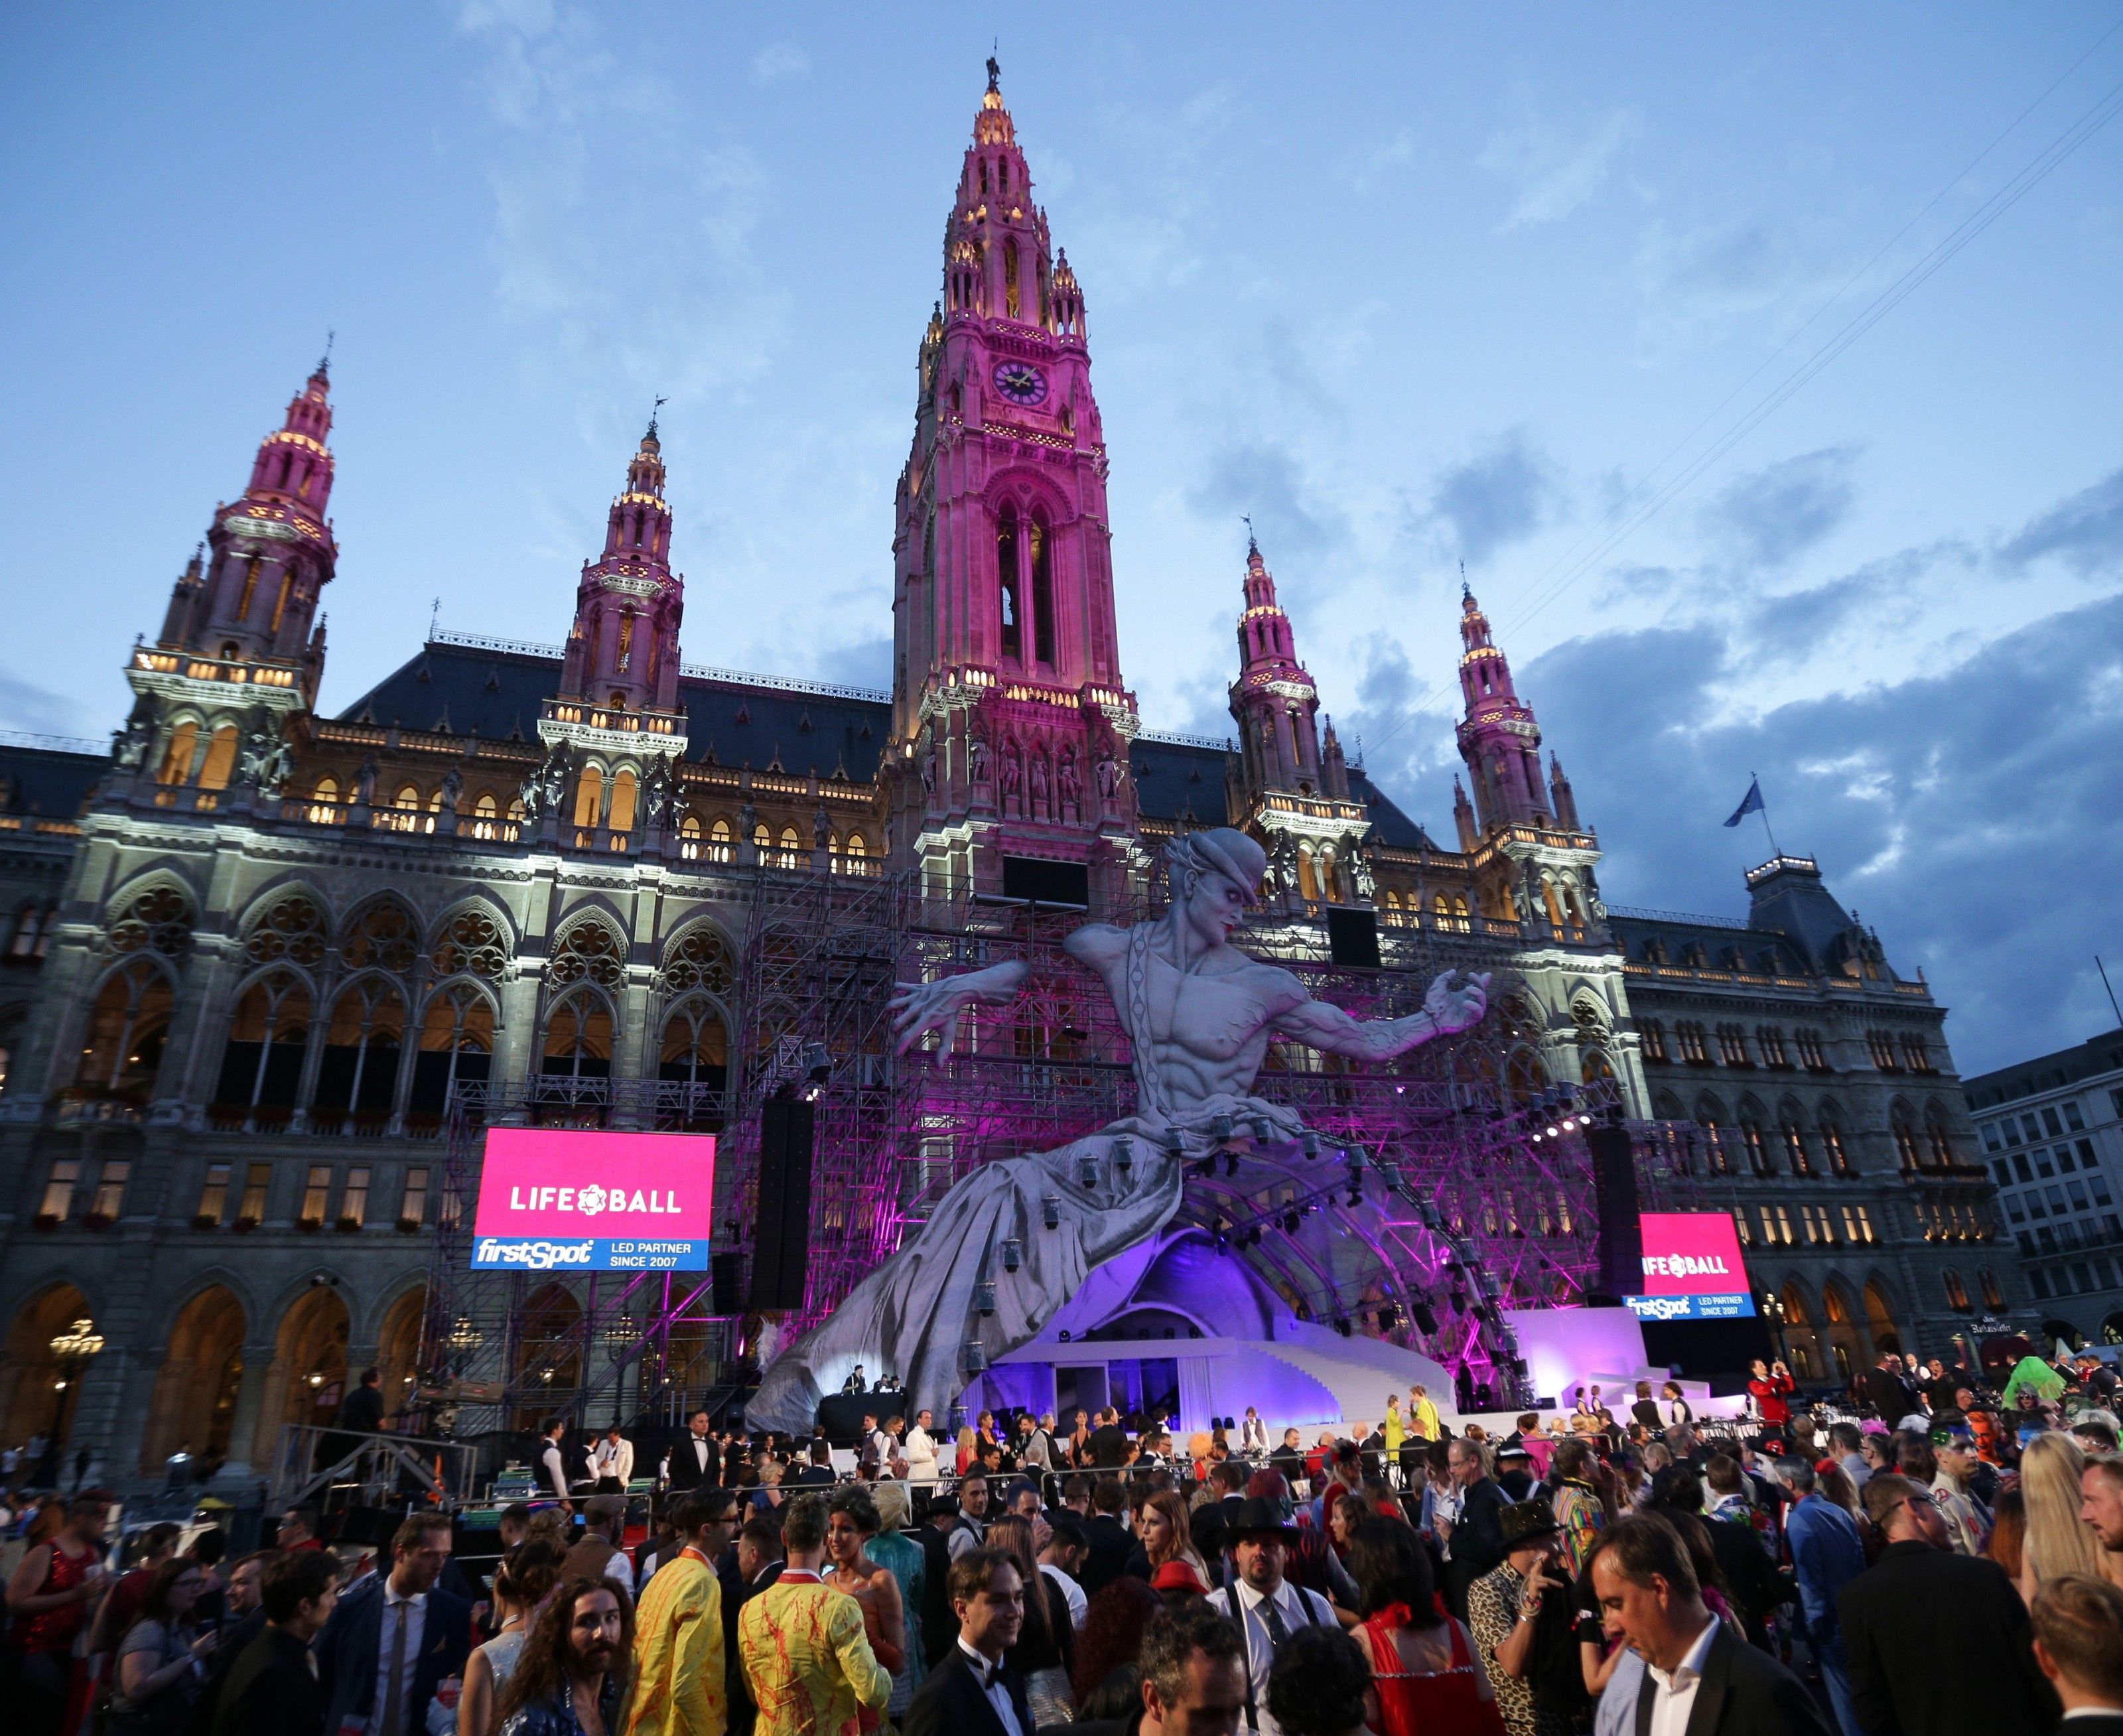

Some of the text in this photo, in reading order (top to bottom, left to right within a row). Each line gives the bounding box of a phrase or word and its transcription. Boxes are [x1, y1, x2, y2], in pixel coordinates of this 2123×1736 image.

[510, 1187, 682, 1213] LIFE BALL
[477, 1239, 594, 1269] firstSpot
[612, 1243, 691, 1254] LED PARTNER
[610, 1256, 677, 1267] SINCE 2007
[1642, 1256, 1729, 1276] IFE BALL
[1712, 1296, 1744, 1305] PARTNER
[1701, 1307, 1721, 1316] SINCE
